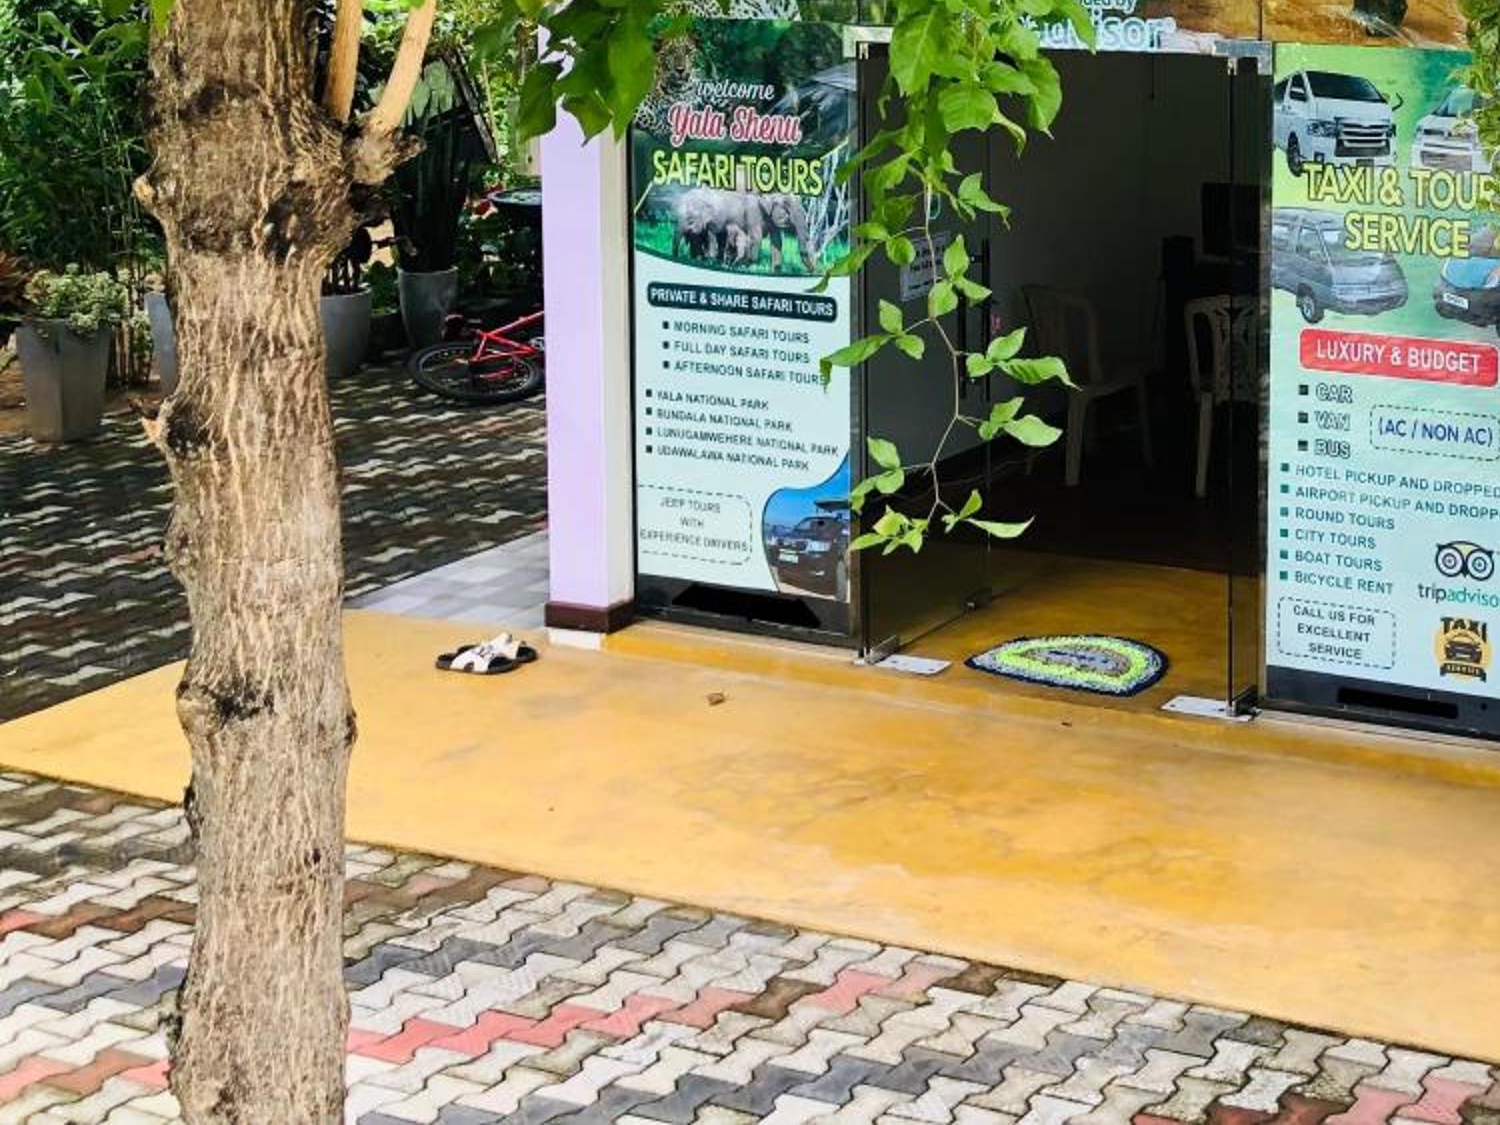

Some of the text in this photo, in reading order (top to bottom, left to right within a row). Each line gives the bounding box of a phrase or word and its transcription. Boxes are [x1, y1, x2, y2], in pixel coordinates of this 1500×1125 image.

[668, 101, 802, 147] Yala Shenu
[652, 149, 823, 196] SAFARI TOURS
[1302, 162, 1374, 205] TAXI
[1379, 168, 1404, 206] &
[1344, 212, 1470, 257] SERVICE
[650, 288, 833, 316] PRIVATE & SHARE SAFARI TOURS
[673, 321, 810, 344] MORNING SAFARI TOURS
[674, 340, 810, 364] FULL DAY SAFARI TOURS
[1316, 338, 1482, 374] LUXURY & BUDGET
[674, 361, 743, 377] AFTERNOON
[745, 366, 785, 382] SAFARI
[657, 390, 769, 410] YALA NATIONAL PARK
[1315, 382, 1353, 403] CAR
[657, 408, 792, 432] BUNDALA NATIONAL PARK
[1314, 410, 1351, 432] VAN
[1379, 416, 1493, 447] (AC / NON AC)
[756, 437, 807, 454] NATIONAL
[811, 444, 839, 457] PARK
[1314, 438, 1351, 459] BUS
[727, 452, 779, 468] NATIONAL
[782, 458, 809, 471] PARK
[1295, 463, 1341, 480] HOTEL
[1345, 469, 1396, 487] PICKUP
[1399, 476, 1429, 491] AND
[660, 497, 721, 514] JEEP TOURS
[1295, 486, 1355, 504] AIRPORT
[1359, 491, 1411, 510] PICKUP
[1414, 500, 1444, 515] AND
[680, 516, 703, 528] WITH
[1295, 506, 1395, 530] ROUND TOURS
[703, 537, 748, 552] DRIVERS
[1294, 528, 1377, 549] CITY TOURS
[1294, 550, 1384, 572] BOAT TOURS
[1294, 571, 1394, 595] BICYCLE RENT
[1293, 605, 1376, 626] CALL US FOR
[1297, 622, 1371, 643] EXCELLENT
[1440, 616, 1488, 643] TAXI
[1308, 642, 1363, 660] SERVICE
